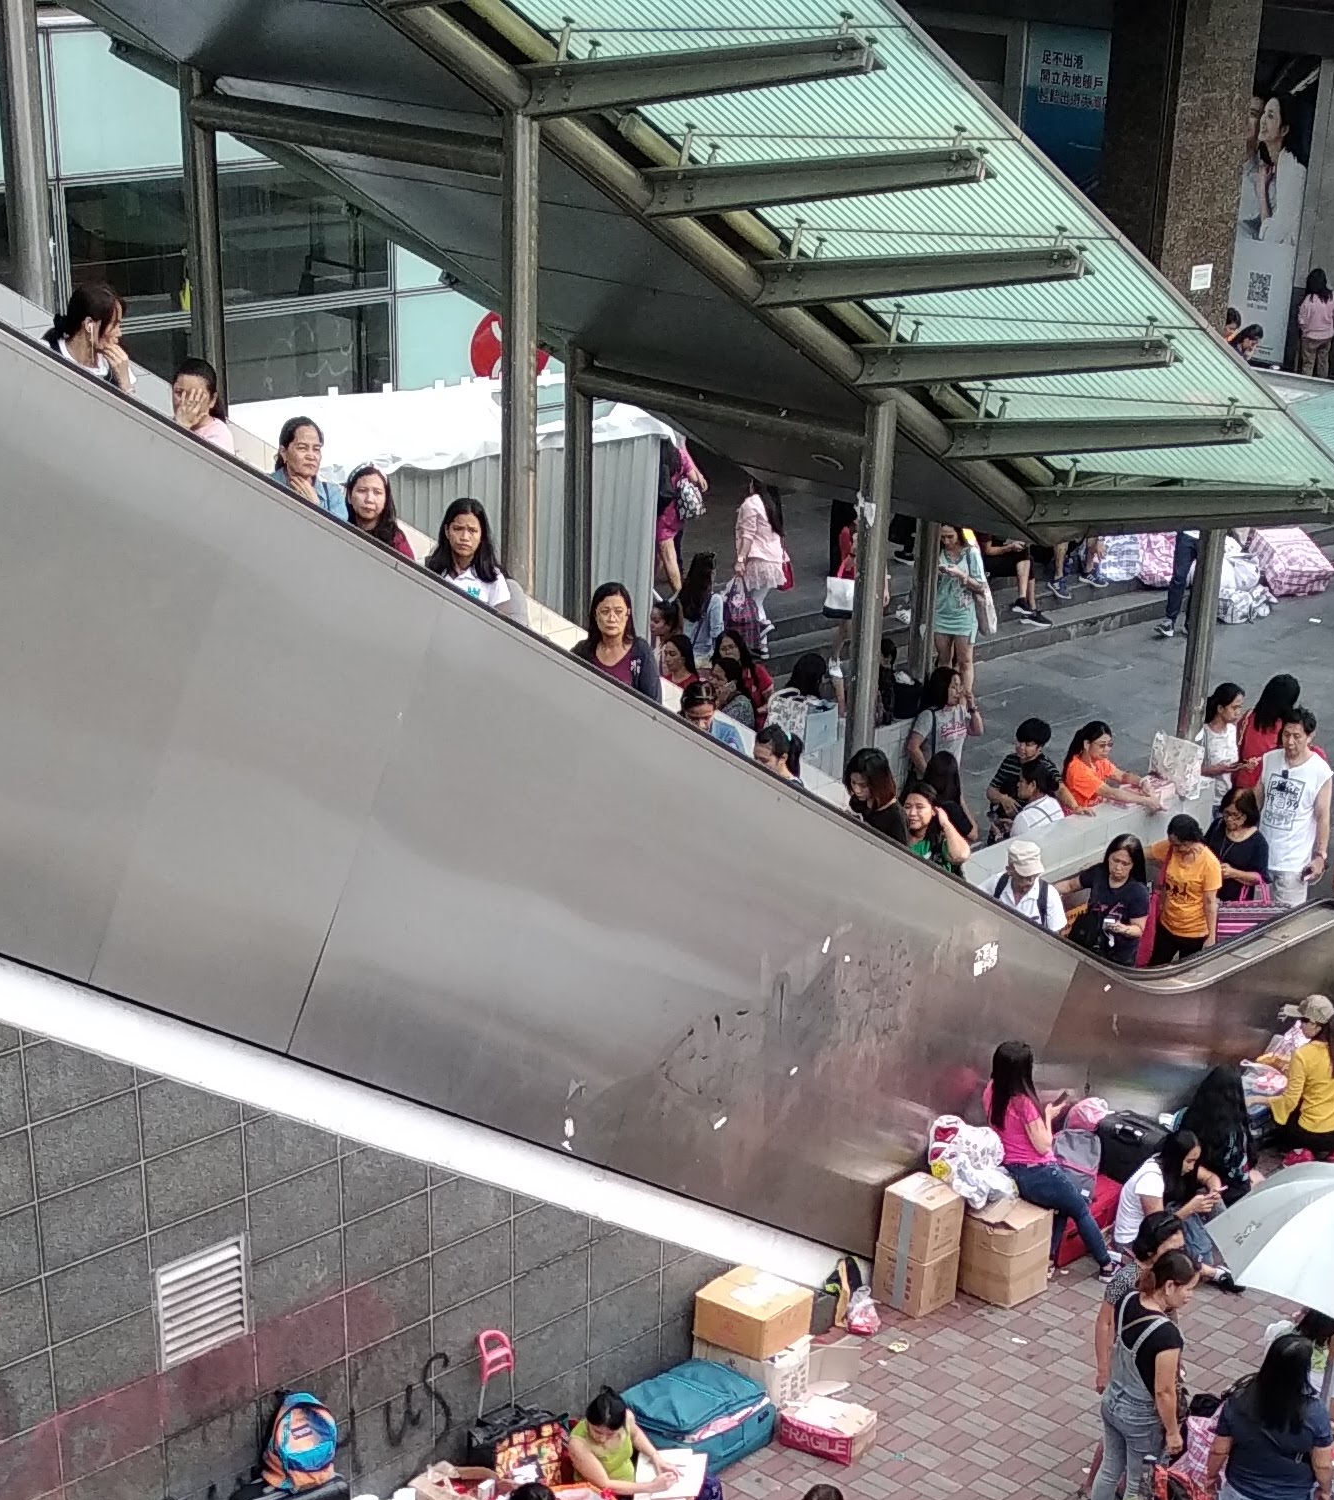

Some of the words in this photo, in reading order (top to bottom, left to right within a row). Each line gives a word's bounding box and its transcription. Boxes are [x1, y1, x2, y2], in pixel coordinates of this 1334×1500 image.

[1041, 49, 1084, 69] 足不出港
[780, 1422, 848, 1455] FRAGILE
